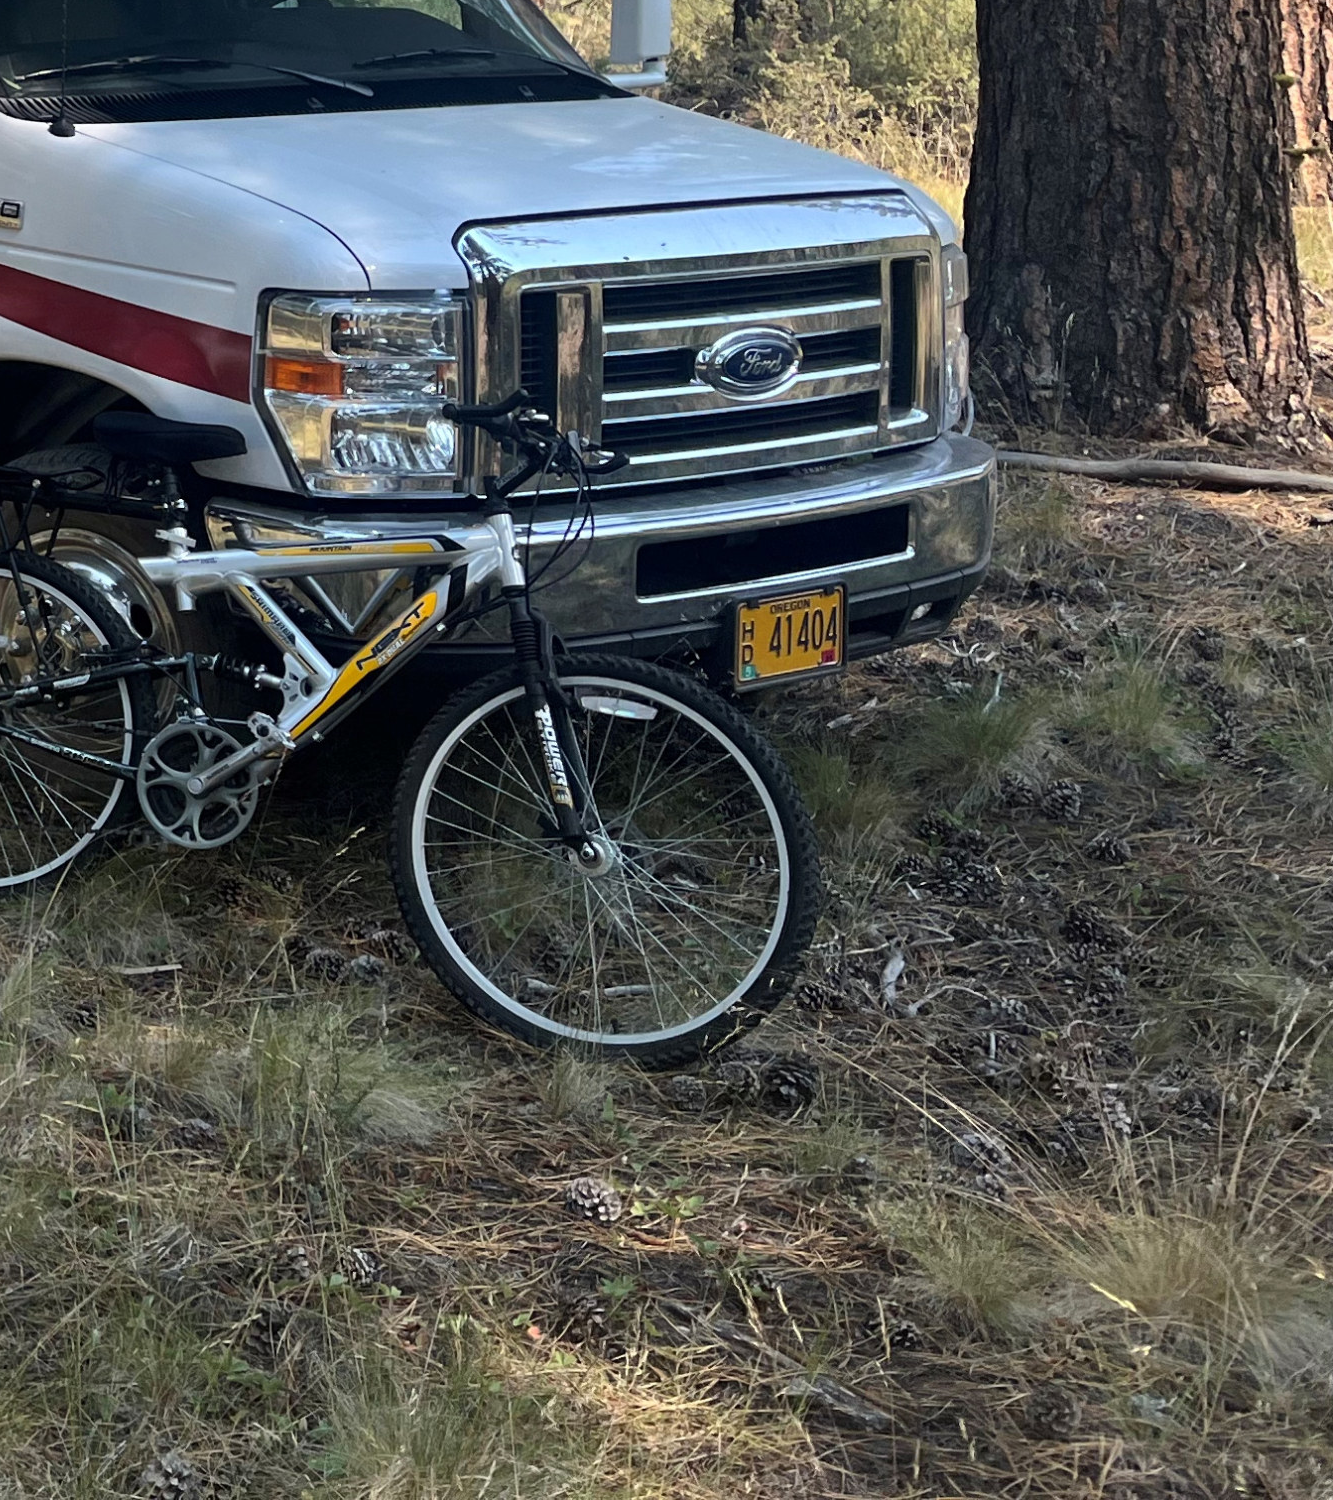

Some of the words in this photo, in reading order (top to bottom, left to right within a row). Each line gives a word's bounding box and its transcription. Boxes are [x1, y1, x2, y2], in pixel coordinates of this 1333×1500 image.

[740, 348, 782, 376] Ford
[770, 599, 810, 614] OREGON
[769, 605, 837, 657] 41404
